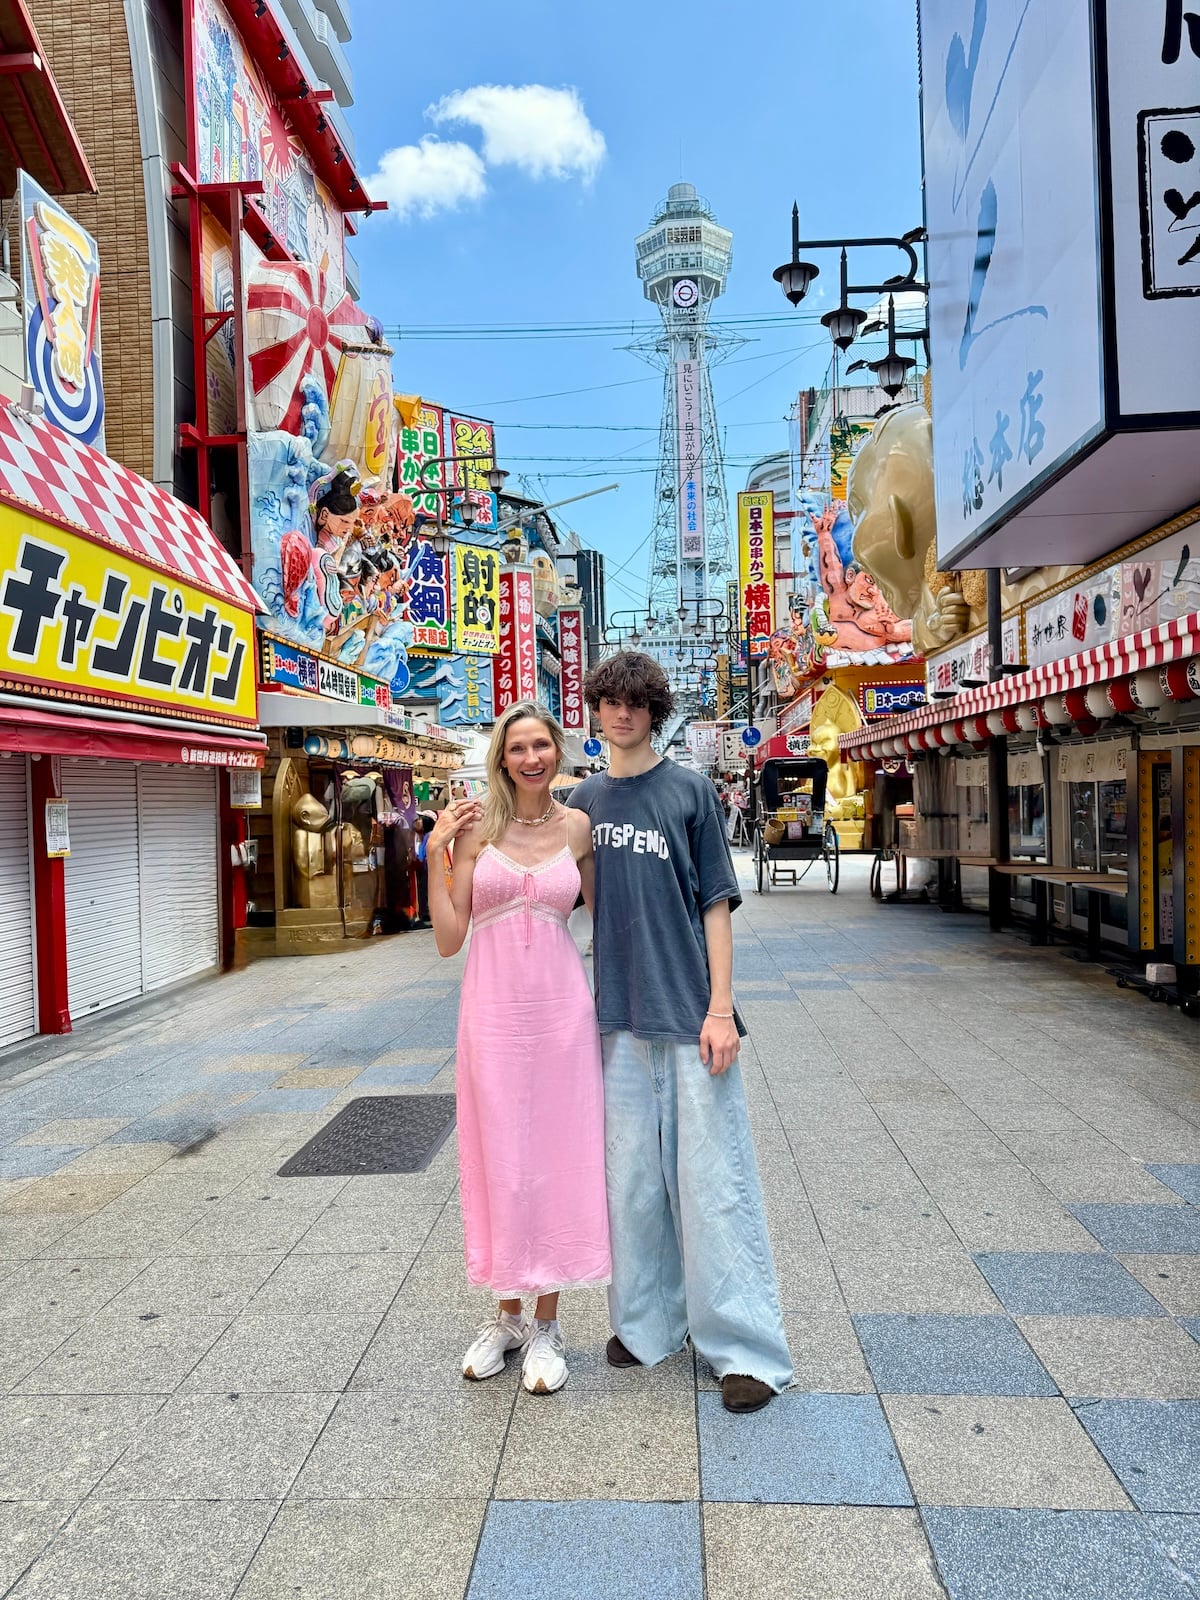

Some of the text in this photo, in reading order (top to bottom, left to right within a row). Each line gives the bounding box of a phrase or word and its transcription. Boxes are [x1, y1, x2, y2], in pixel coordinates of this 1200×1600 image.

[455, 423, 492, 453] 24
[749, 507, 764, 582] 日本一の串かつ
[462, 550, 495, 631] 射的
[518, 580, 531, 615] 名物
[4, 540, 245, 701] チャンピオン
[413, 626, 448, 646] 天閣店
[462, 639, 496, 649] チャンピオン
[562, 631, 580, 726] 珍味てっちり
